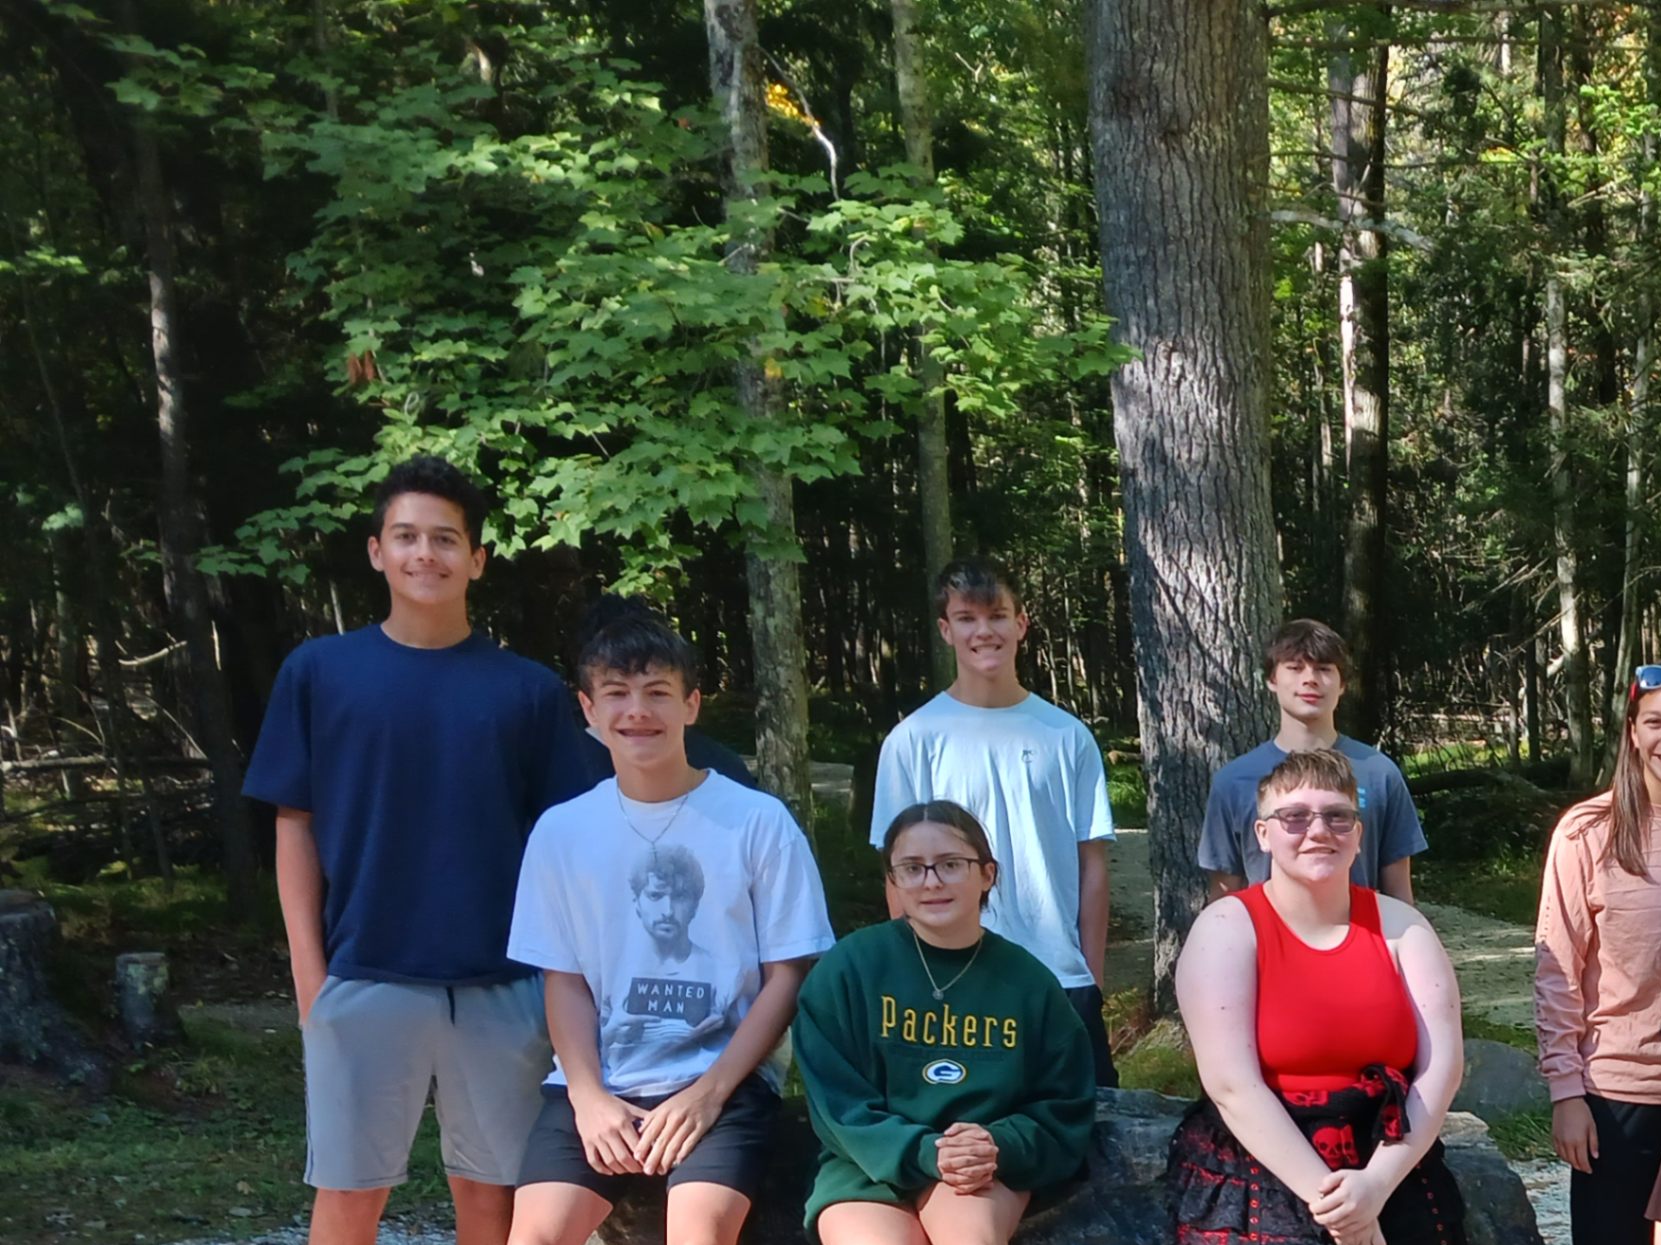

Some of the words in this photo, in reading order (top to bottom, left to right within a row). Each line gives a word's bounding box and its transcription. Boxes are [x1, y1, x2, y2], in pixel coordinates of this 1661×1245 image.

[637, 983, 705, 999] WANTED
[647, 1000, 685, 1014] MAN
[881, 996, 1017, 1048] Packers
